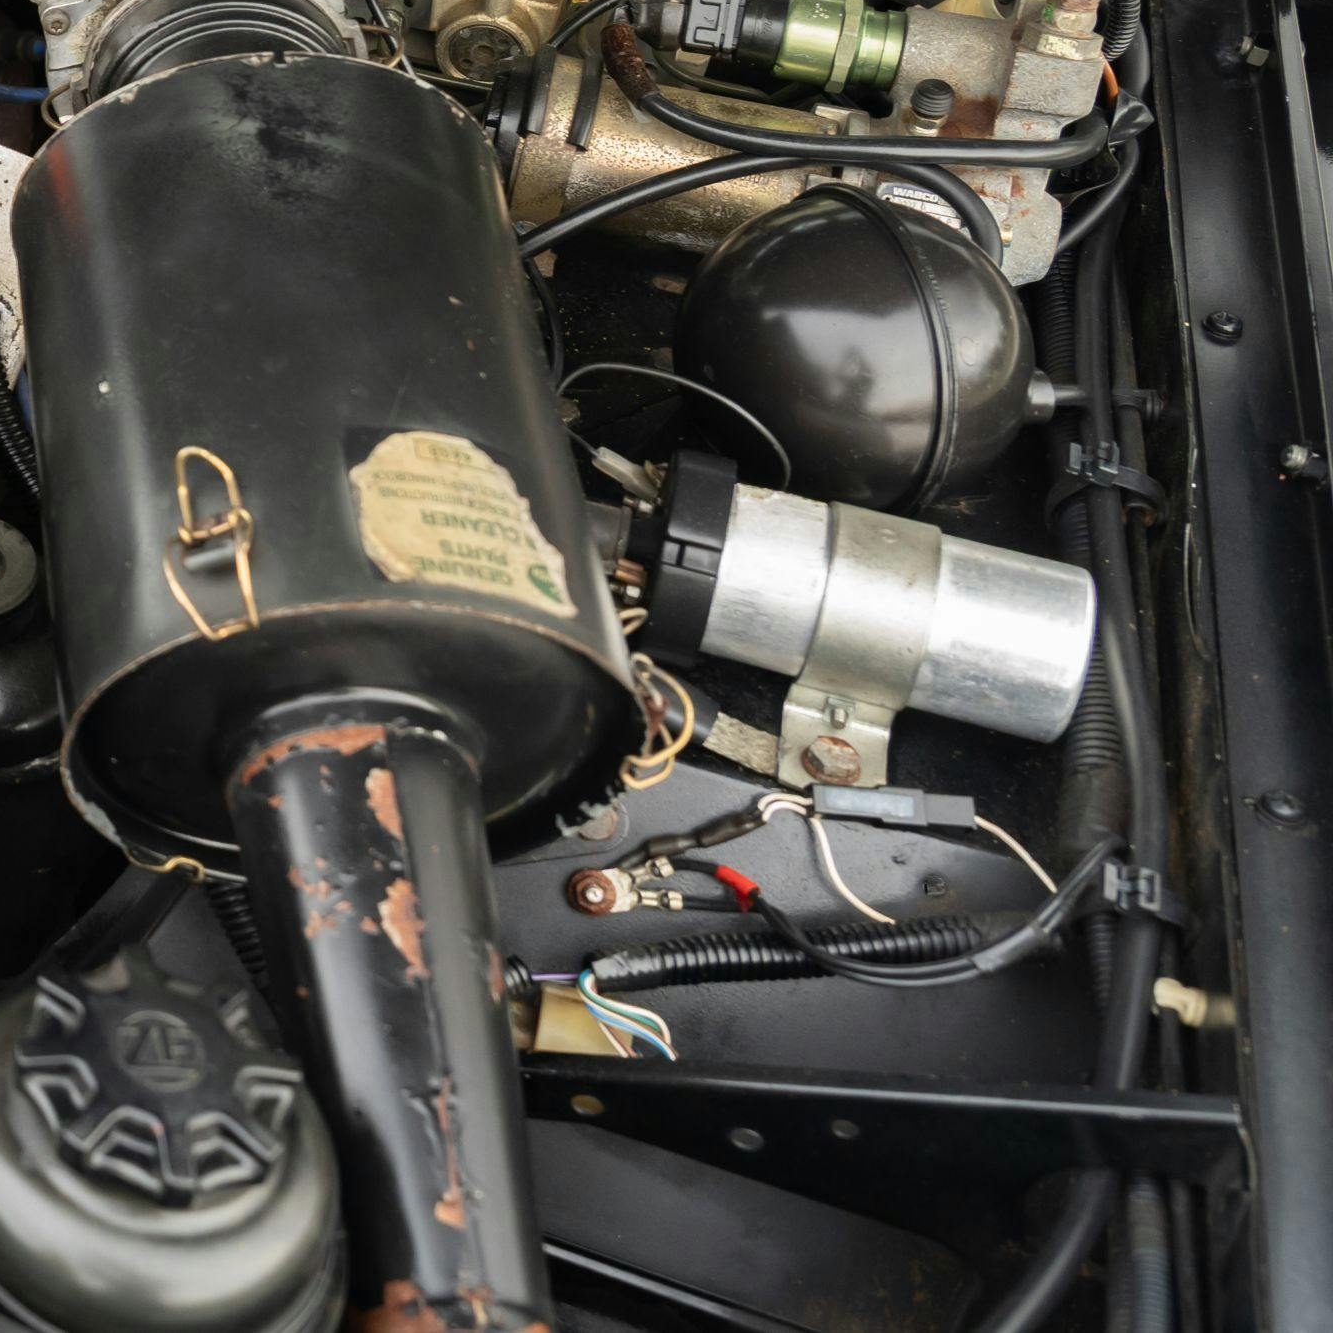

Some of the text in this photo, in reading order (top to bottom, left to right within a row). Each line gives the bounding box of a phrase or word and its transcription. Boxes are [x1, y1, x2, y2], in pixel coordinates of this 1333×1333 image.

[893, 186, 939, 204] WABCO
[421, 507, 521, 543] CLEANER
[439, 538, 508, 566] PARTS
[411, 555, 514, 586] GENUINE
